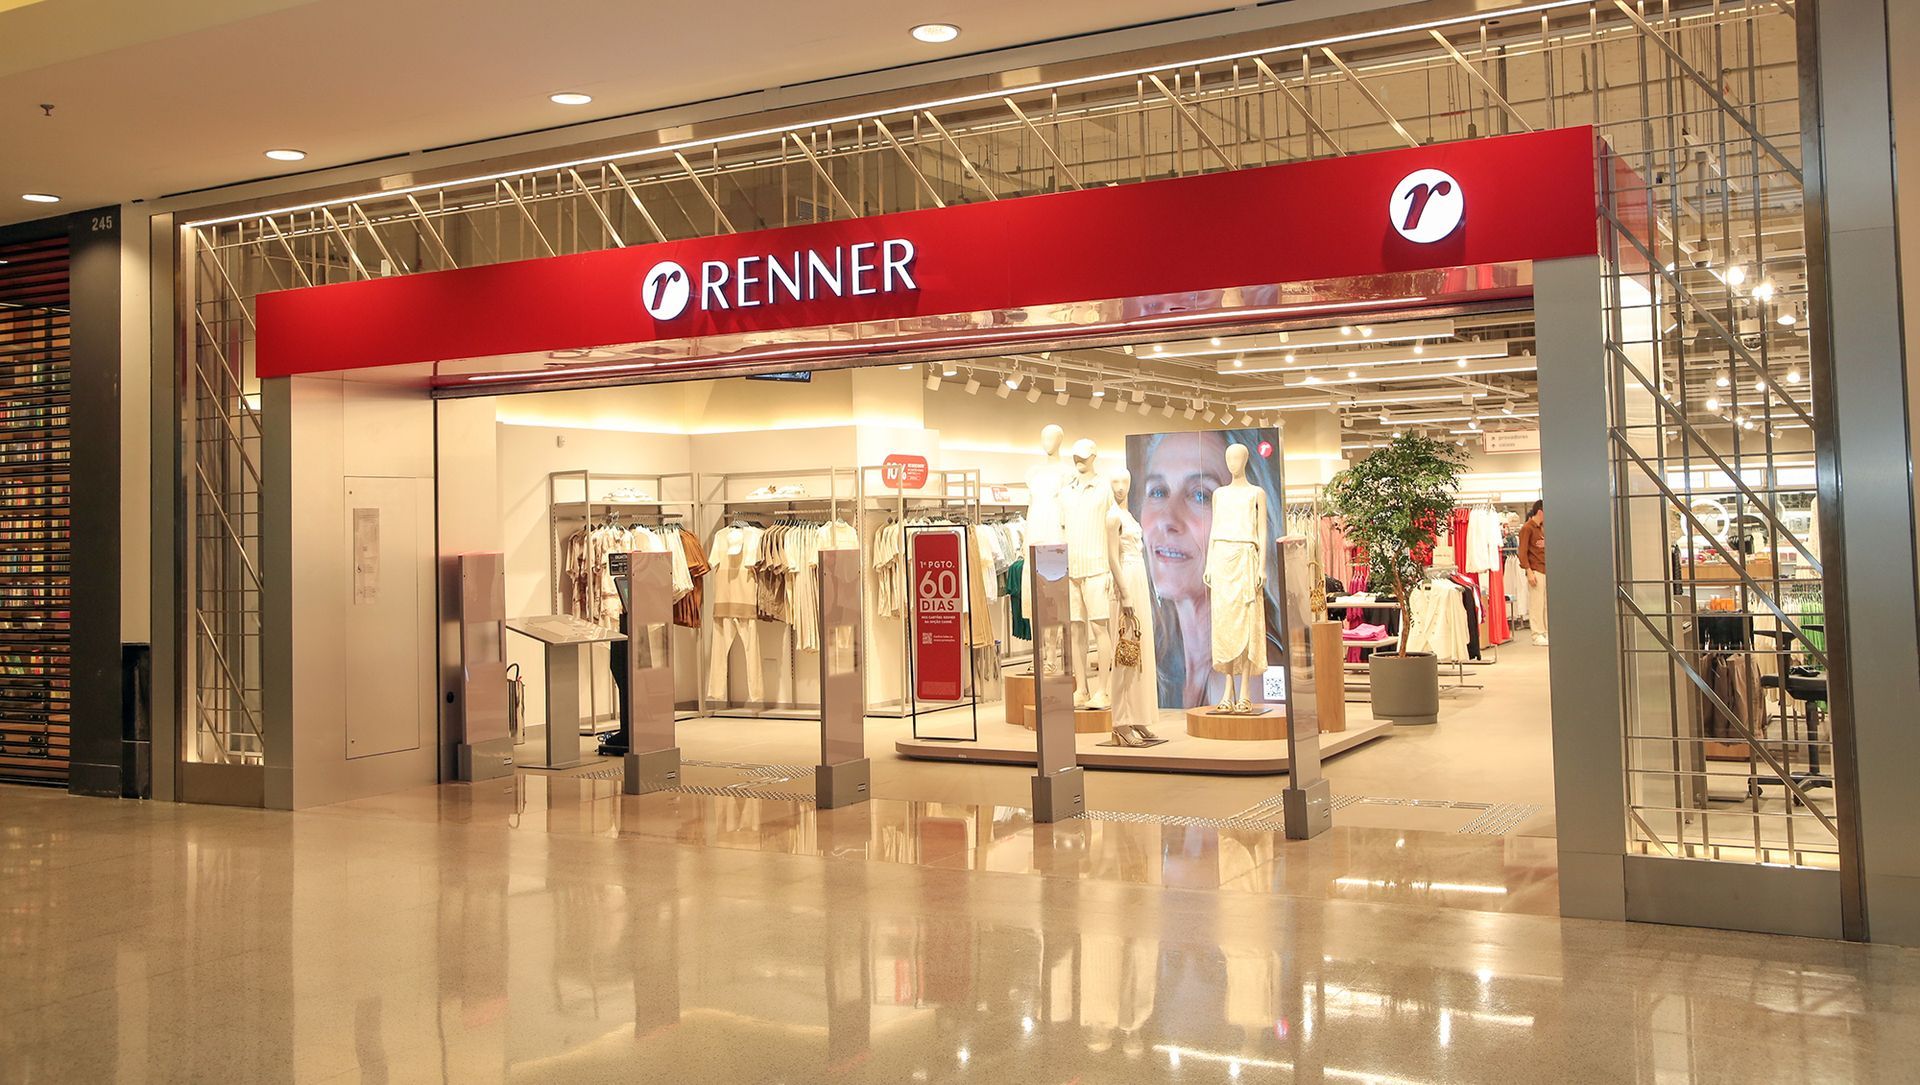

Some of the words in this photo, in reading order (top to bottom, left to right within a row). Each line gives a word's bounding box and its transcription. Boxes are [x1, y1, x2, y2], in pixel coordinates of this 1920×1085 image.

[91, 215, 113, 231] 245
[701, 238, 917, 311] RENNER
[928, 560, 955, 569] PGTO.
[919, 570, 957, 599] 60
[921, 600, 955, 611] DIAS
